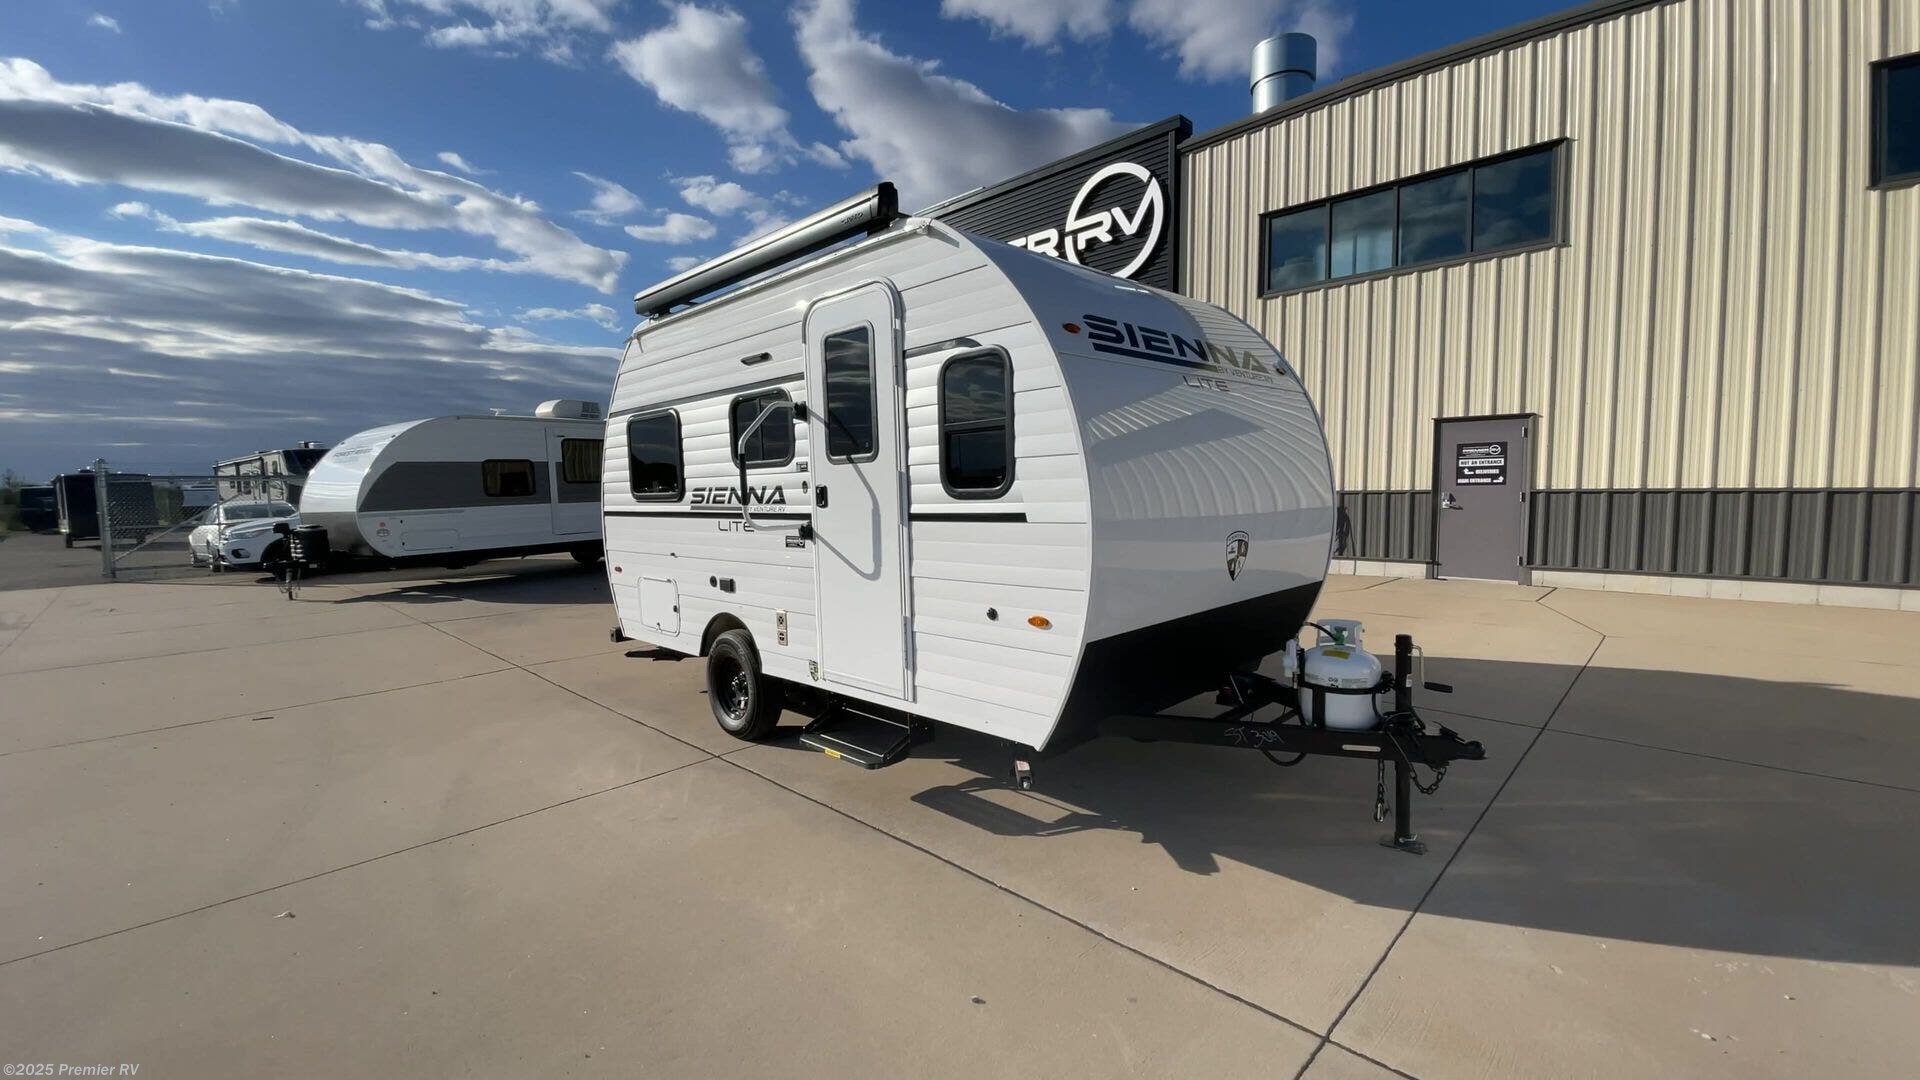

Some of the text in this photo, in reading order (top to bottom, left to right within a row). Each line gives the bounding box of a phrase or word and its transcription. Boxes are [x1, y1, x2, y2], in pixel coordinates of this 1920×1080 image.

[1083, 314, 1270, 374] SIENNA
[1182, 375, 1231, 392] LITE
[690, 485, 787, 505] SIENNA
[717, 520, 755, 533] LITE
